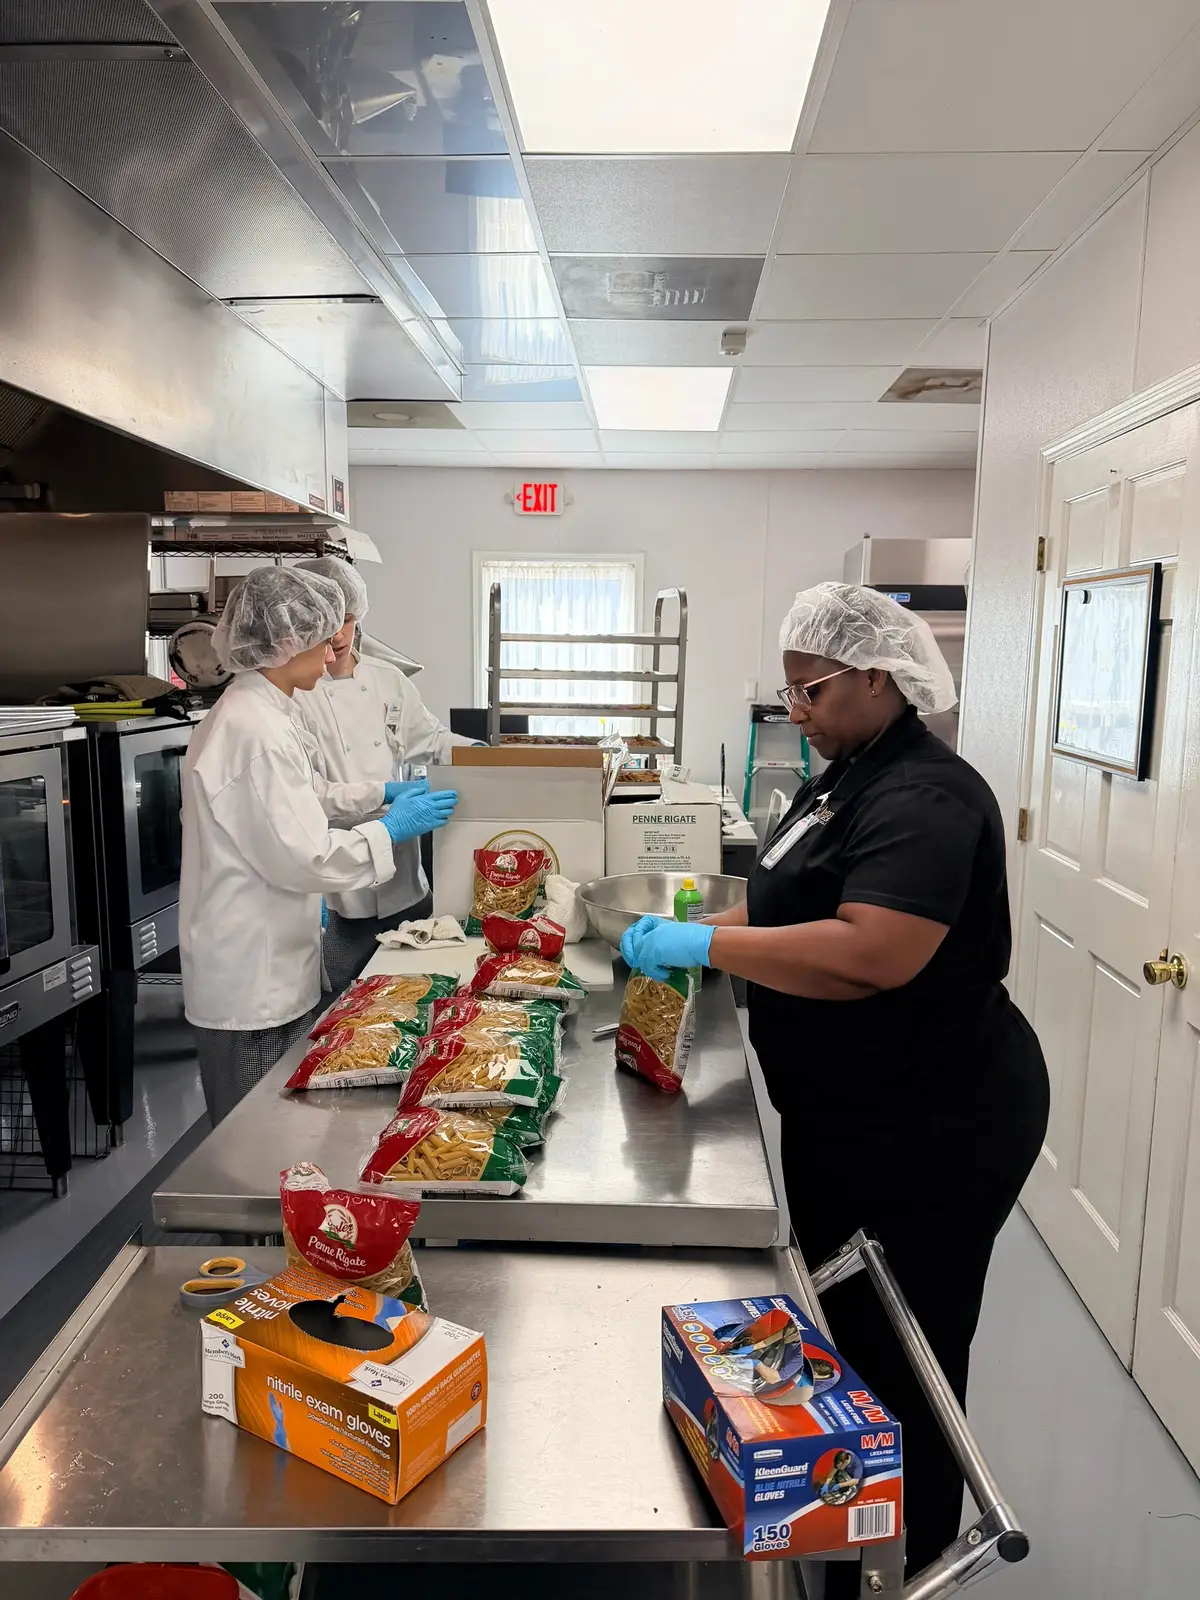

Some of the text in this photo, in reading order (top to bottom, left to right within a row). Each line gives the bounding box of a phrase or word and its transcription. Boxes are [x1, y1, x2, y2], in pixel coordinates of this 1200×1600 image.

[522, 483, 558, 512] EXIT
[632, 815, 696, 823] PENNE RIGATE
[308, 1235, 367, 1267] Penne Rigate
[234, 1297, 280, 1320] nitrile
[680, 1306, 698, 1321] 150
[215, 1312, 236, 1324] Large
[363, 1366, 379, 1377] Mark
[421, 1384, 441, 1404] MONEY
[440, 1374, 454, 1391] BACK
[453, 1350, 481, 1377] GUARANTEE
[267, 1375, 302, 1401] nitrile
[306, 1395, 343, 1421] exam
[346, 1413, 391, 1448] gloves
[824, 1396, 851, 1426] POWDER-FREE
[840, 1399, 864, 1425] LATEX-FREE
[847, 1390, 889, 1423] M/M
[373, 1408, 392, 1424] Large
[860, 1432, 894, 1449] M/M
[864, 1457, 895, 1465] POWDER-FREE
[869, 1449, 895, 1457] LATEX-FREE
[754, 1463, 808, 1477] KleenGuard
[754, 1478, 807, 1493] BLUE NITRILE
[754, 1490, 786, 1502] GLOVES
[753, 1523, 792, 1543] 150
[753, 1540, 790, 1552] Gloves
